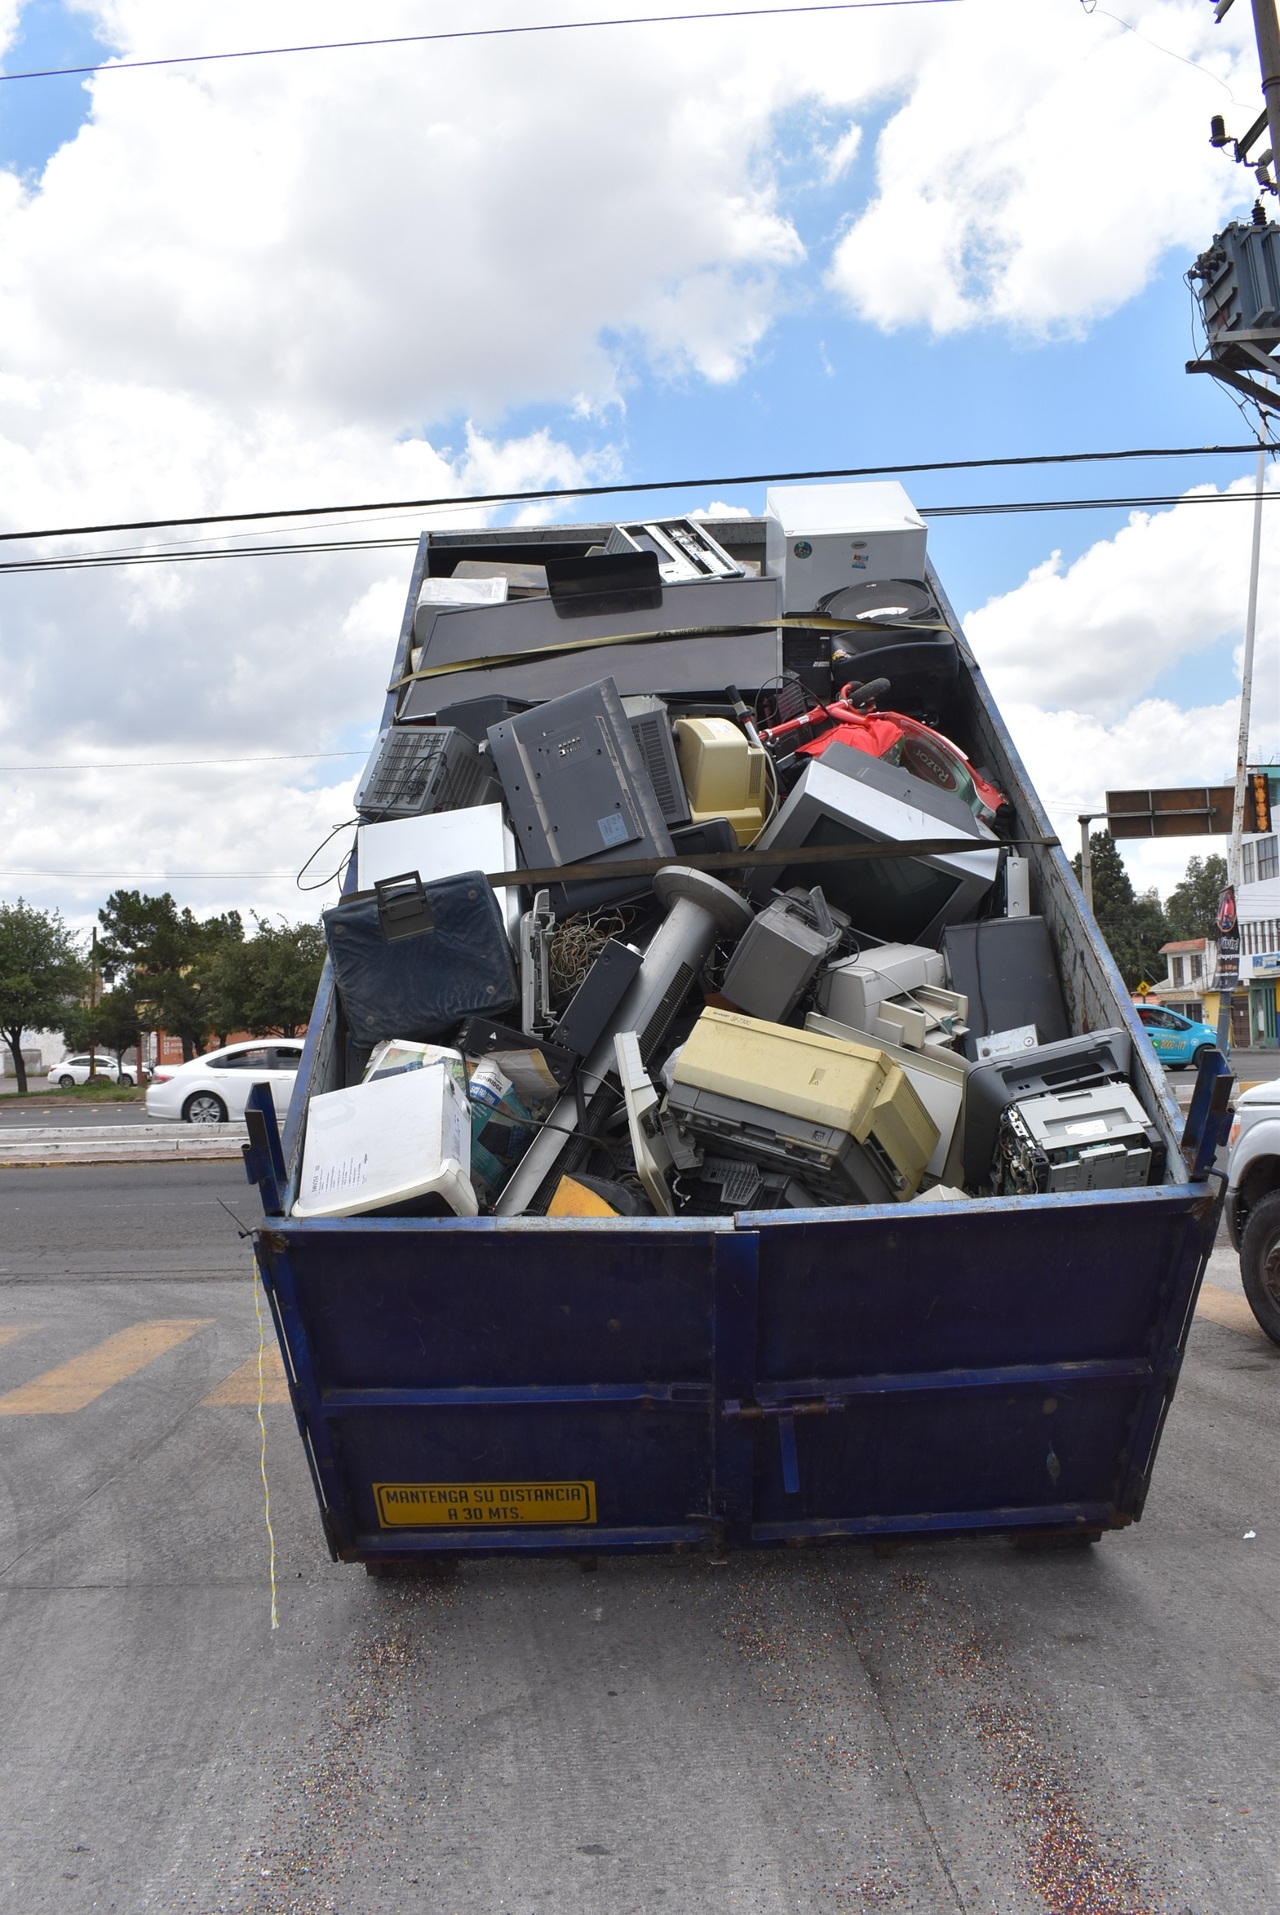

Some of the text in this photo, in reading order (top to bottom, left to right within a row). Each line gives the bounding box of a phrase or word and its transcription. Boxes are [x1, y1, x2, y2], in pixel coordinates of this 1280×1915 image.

[913, 749, 949, 783] Razor
[476, 1074, 503, 1092] SUNRIDGE
[386, 1488, 581, 1504] MANTENGA SU DISTANCIA
[449, 1506, 524, 1520] A 30 MTS.
